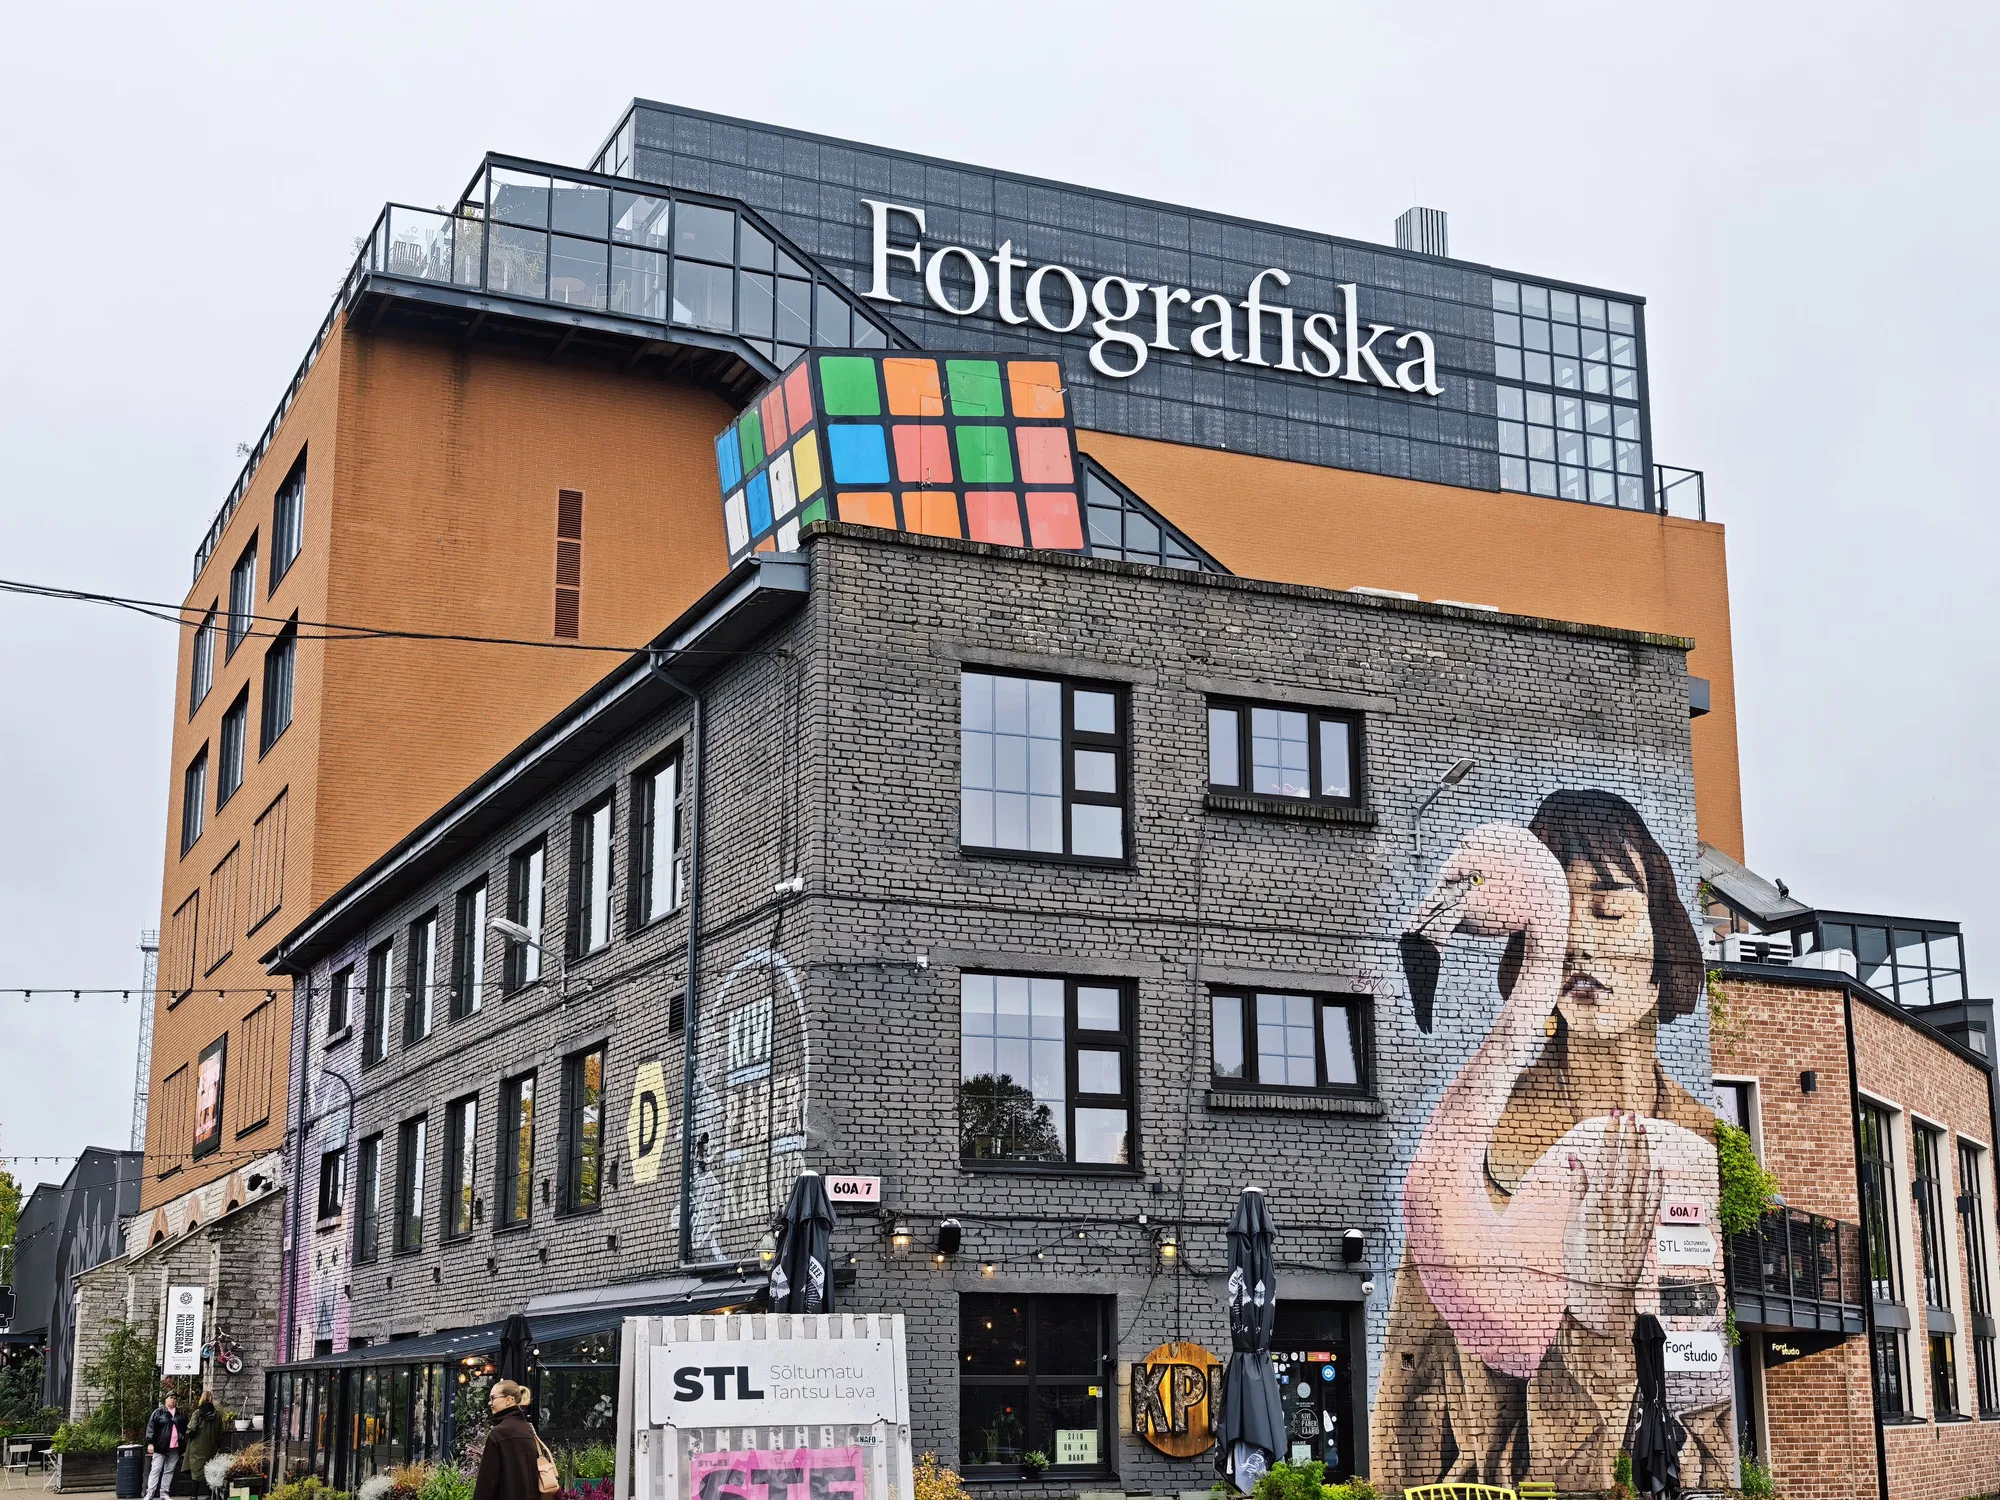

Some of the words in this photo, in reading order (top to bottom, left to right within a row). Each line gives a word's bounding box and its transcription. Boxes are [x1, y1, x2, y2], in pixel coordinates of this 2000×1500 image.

[860, 197, 1446, 398] Fotografiska
[638, 1089, 659, 1159] D
[833, 1181, 873, 1196] 60A/7
[1669, 1205, 1699, 1218] 60A/7
[1658, 1239, 1681, 1253] STL
[173, 1313, 186, 1354] KATUSEBAAR
[184, 1313, 195, 1347] RESTORAN
[1683, 1350, 1718, 1362] studio
[1781, 1346, 1800, 1356] studio
[769, 1364, 864, 1380] Sõltumatu
[672, 1365, 765, 1403] STL
[769, 1384, 830, 1400] Tantsu
[834, 1383, 876, 1399] Lava
[859, 1435, 877, 1445] NAFO
[1067, 1432, 1084, 1440] SIIN
[1063, 1443, 1072, 1451] ON
[1080, 1443, 1088, 1451] KA
